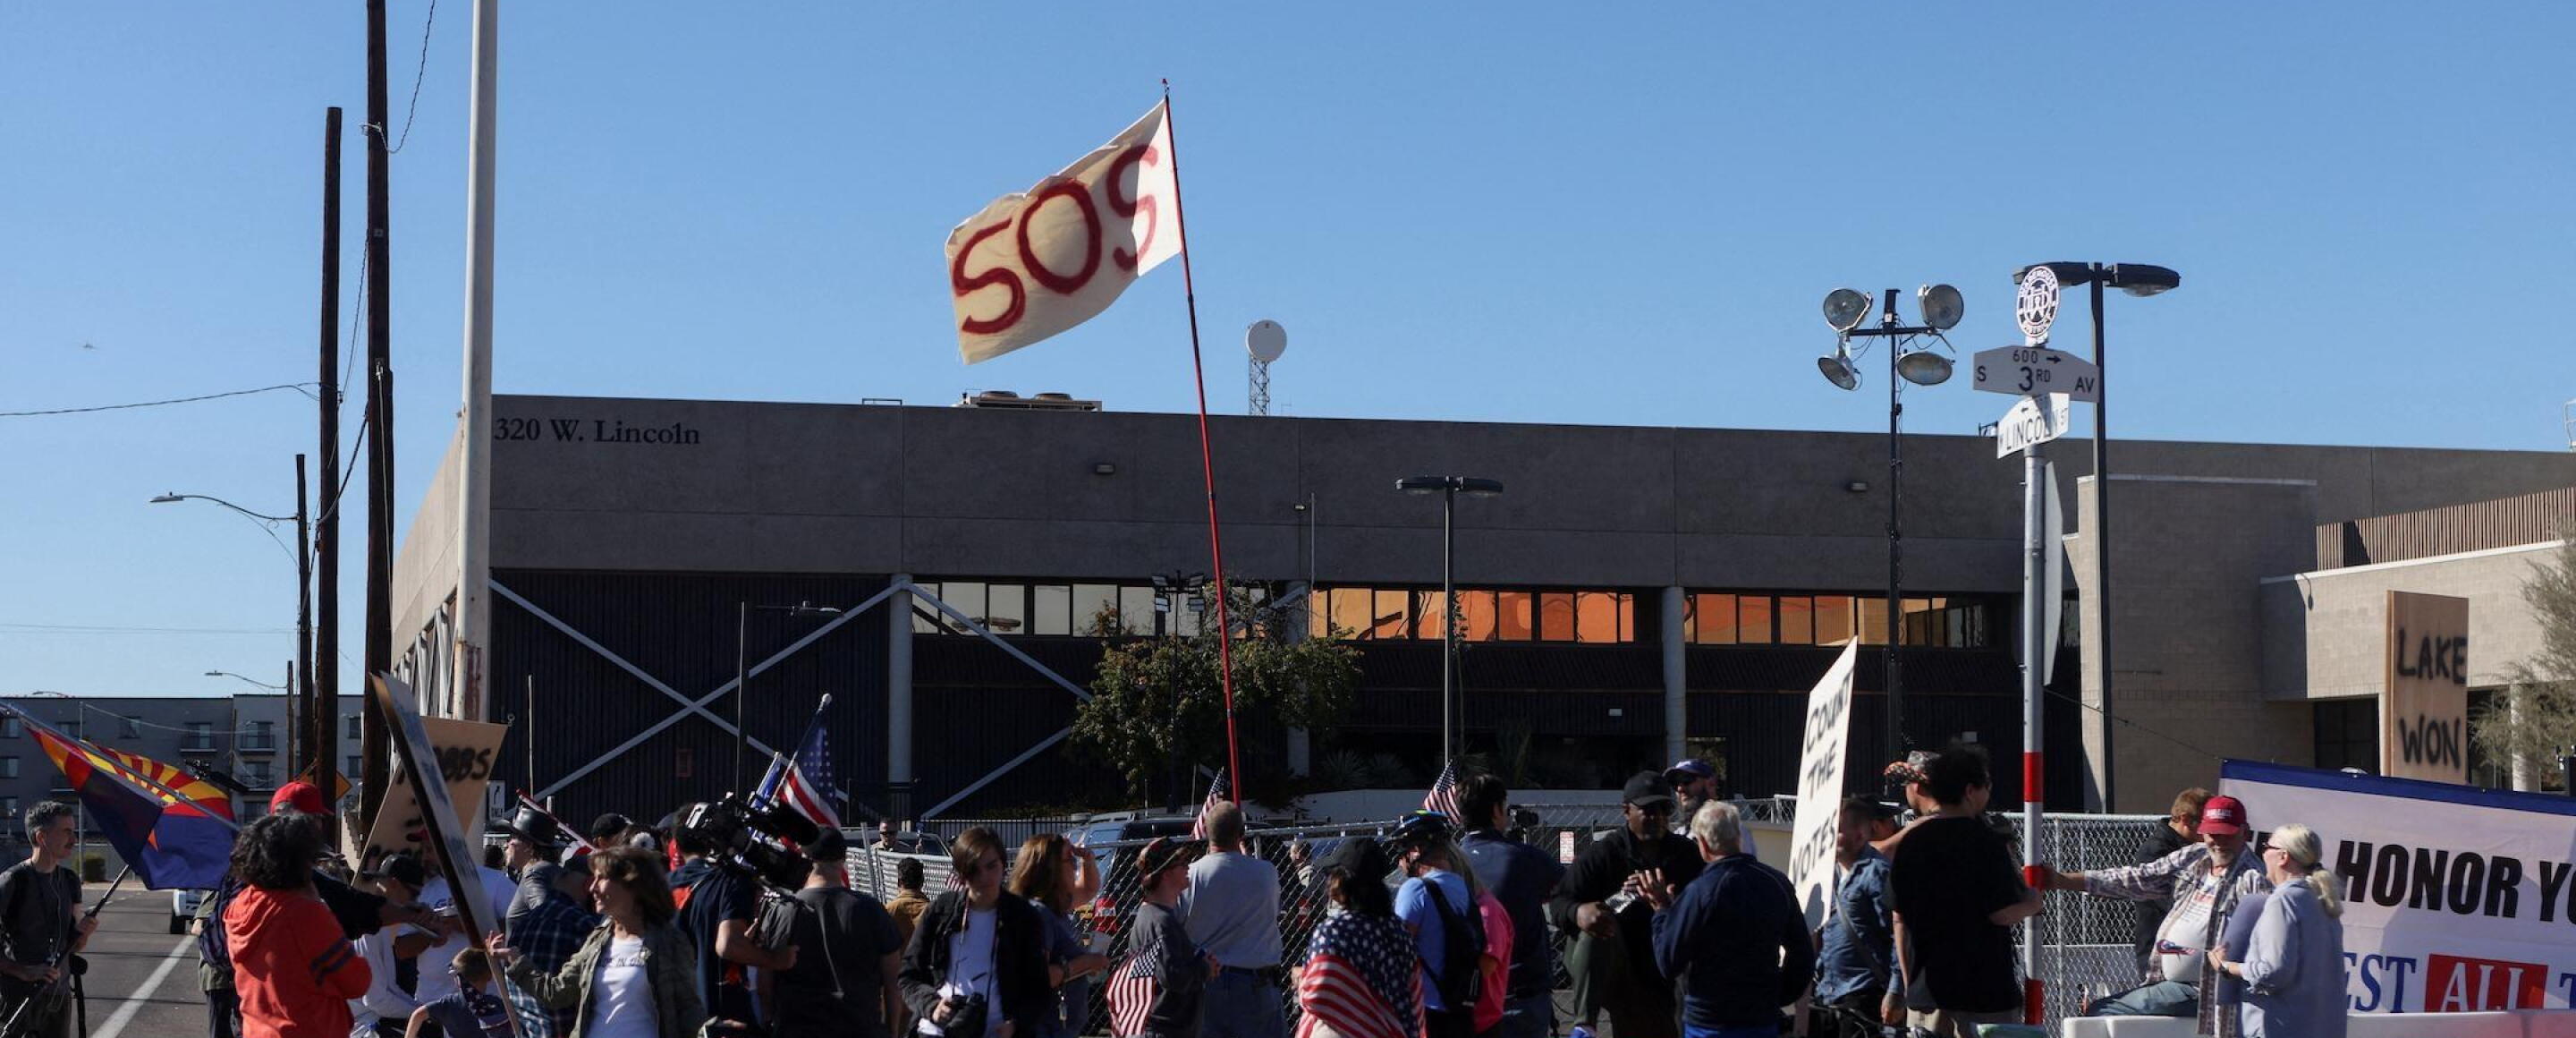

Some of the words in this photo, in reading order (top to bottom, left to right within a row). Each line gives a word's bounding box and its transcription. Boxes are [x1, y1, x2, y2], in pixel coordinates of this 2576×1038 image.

[953, 143, 1158, 335] SOS
[1976, 365, 1987, 382] S
[2018, 366, 2051, 392] 3RD
[2074, 377, 2096, 393] AV
[2012, 349, 2038, 364] 600
[494, 417, 540, 441] 320
[550, 418, 584, 442] W.
[593, 419, 700, 445] Lincoln
[2006, 409, 2059, 450] LINCOLN
[2397, 628, 2468, 685] LAKE
[1806, 667, 1854, 754] COUNT
[2400, 713, 2461, 770] WON
[1807, 739, 1837, 802] THE
[1792, 809, 1838, 886] VOTES
[2335, 839, 2523, 919] HONOR
[2539, 861, 2576, 925] Y
